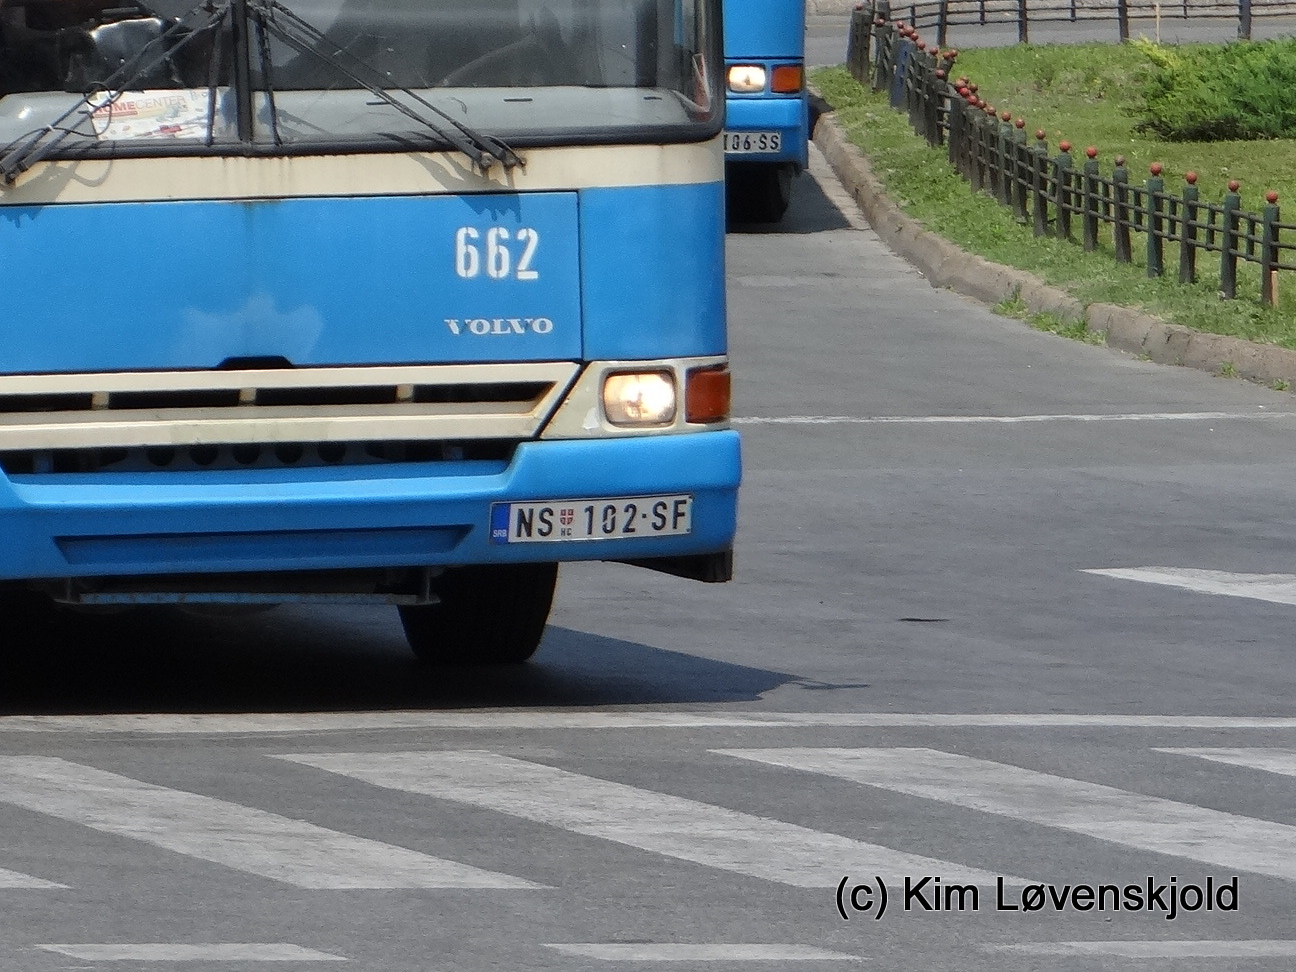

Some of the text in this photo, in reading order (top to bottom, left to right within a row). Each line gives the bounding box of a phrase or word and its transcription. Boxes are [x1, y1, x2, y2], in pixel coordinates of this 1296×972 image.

[456, 227, 539, 279] 662
[444, 317, 554, 335] VOLVO
[492, 529, 508, 538] SRB
[516, 507, 554, 538] NS
